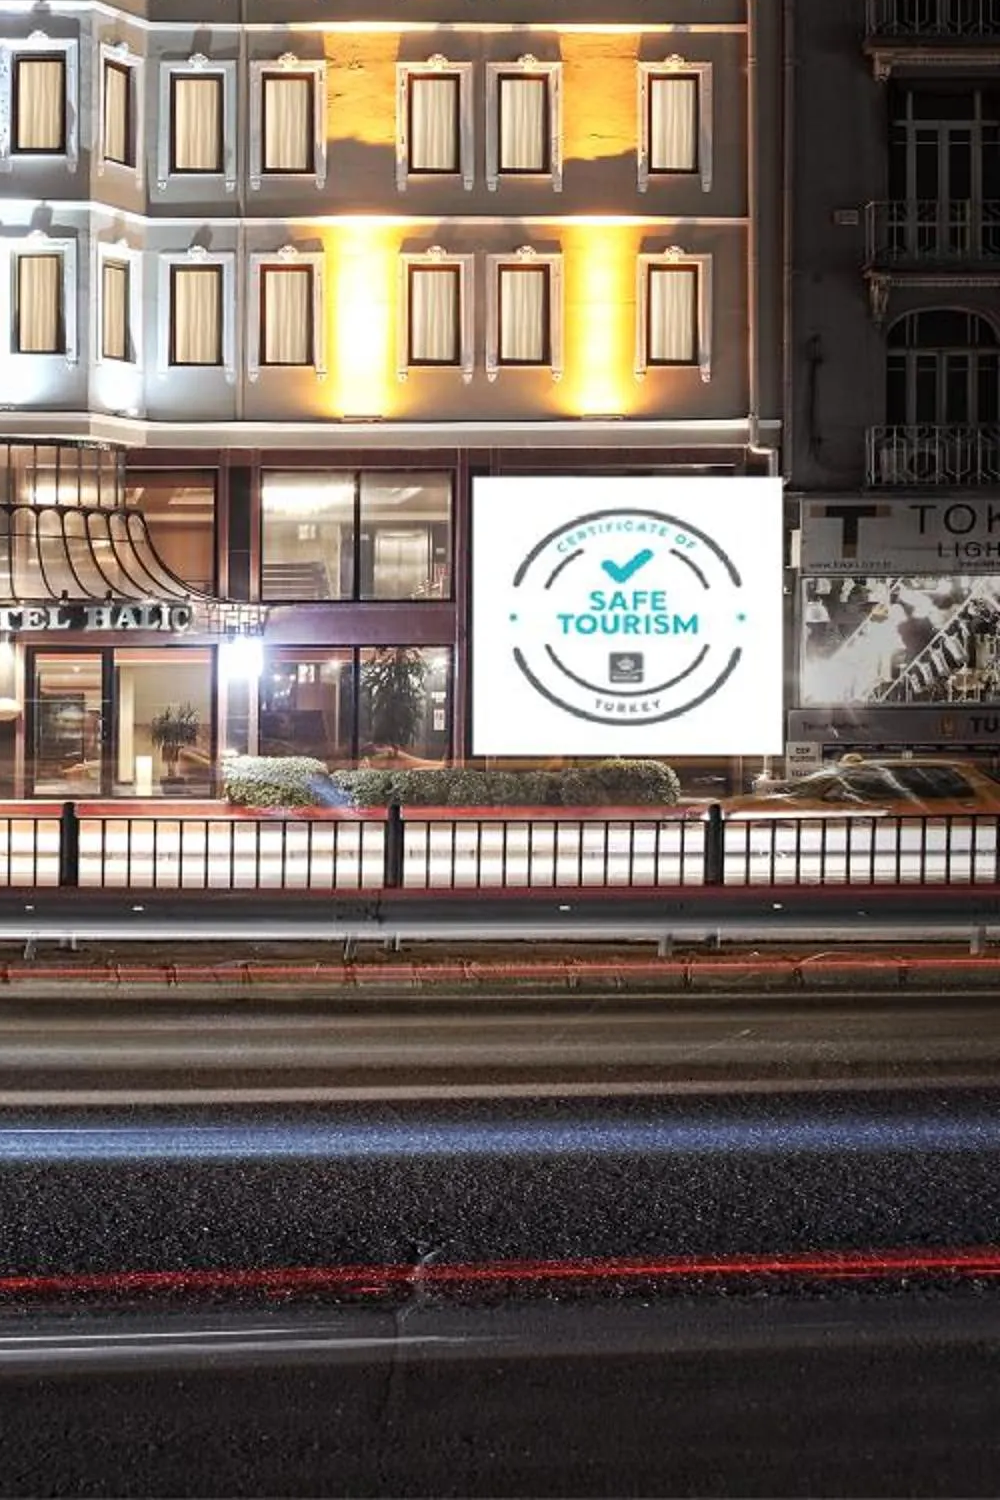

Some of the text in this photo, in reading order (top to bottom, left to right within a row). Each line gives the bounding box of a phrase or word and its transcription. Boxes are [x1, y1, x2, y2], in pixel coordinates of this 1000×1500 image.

[557, 520, 697, 553] CERTIFICATE OF
[590, 590, 667, 611] SAFE
[556, 614, 698, 635] TOURISM
[595, 699, 660, 713] TURKEY
